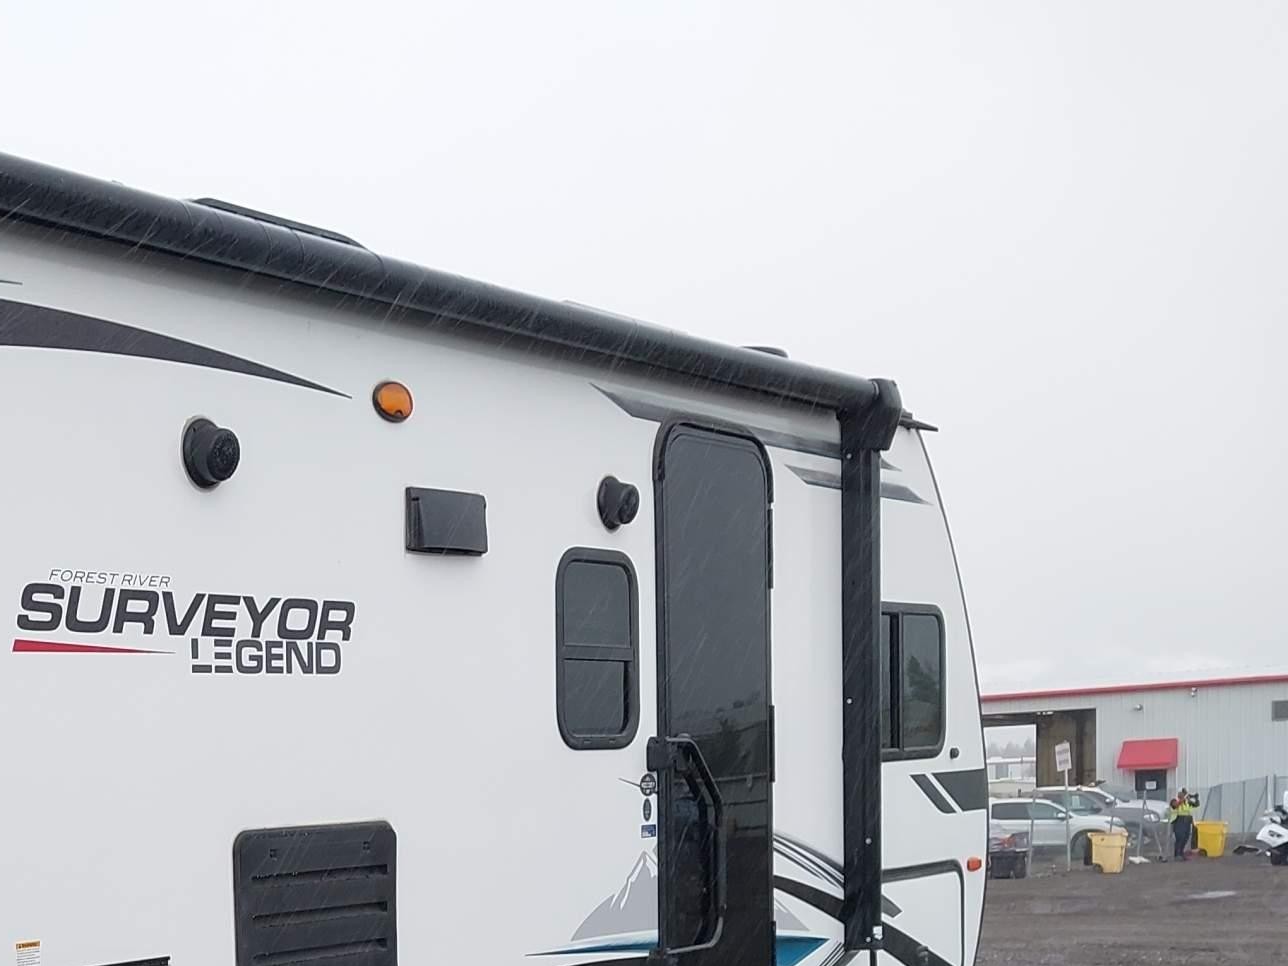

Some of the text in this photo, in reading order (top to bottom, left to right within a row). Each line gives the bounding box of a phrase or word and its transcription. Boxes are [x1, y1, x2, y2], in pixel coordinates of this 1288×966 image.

[48, 569, 171, 588] FOREST RIVER
[16, 582, 356, 642] SURVEYOR
[191, 638, 342, 675] LEGEND
